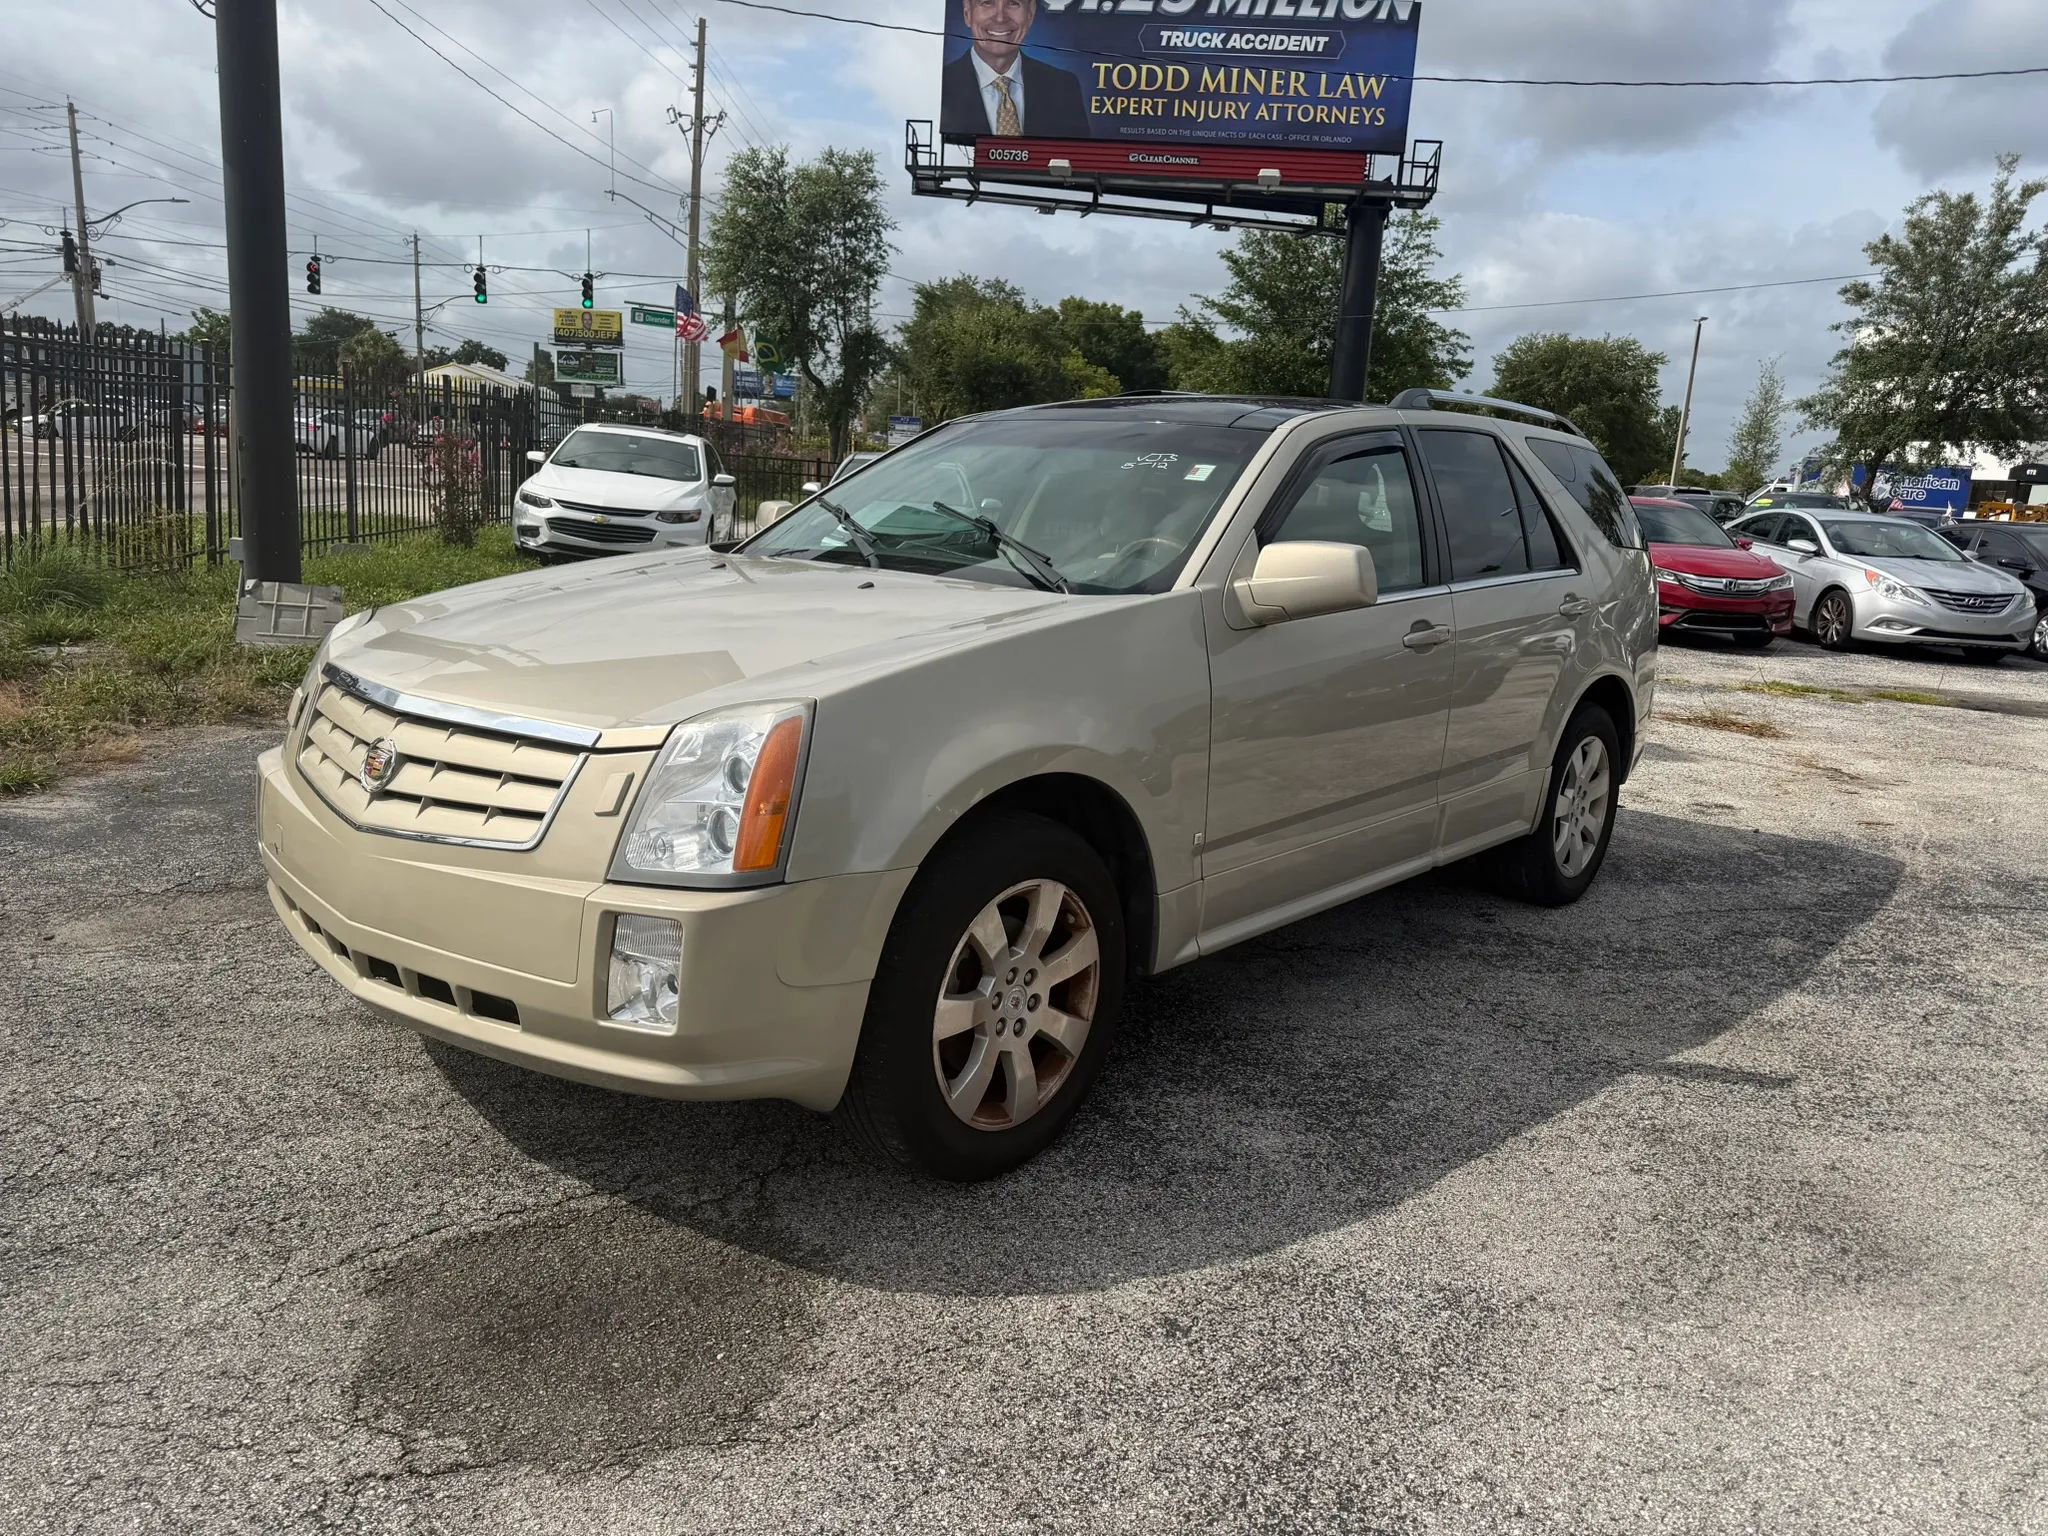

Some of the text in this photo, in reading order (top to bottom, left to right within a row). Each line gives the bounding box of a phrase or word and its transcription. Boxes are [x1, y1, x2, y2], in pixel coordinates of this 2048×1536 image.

[1160, 31, 1329, 52] TRUCK ACCIDENT
[1092, 62, 1387, 101] TODD MINER LAW
[1090, 95, 1386, 126] EXPERT INJURY ATTORNEYS
[1120, 127, 1145, 135] RESULTS
[1147, 128, 1166, 136] BASED
[1179, 129, 1190, 137] THE
[1192, 130, 1216, 138] UNIQUE
[1218, 131, 1237, 139] FACTS
[1249, 132, 1266, 140] EACH
[1267, 133, 1283, 141] CASE
[1288, 134, 1310, 142] OFFICE
[989, 149, 1029, 161] 005736
